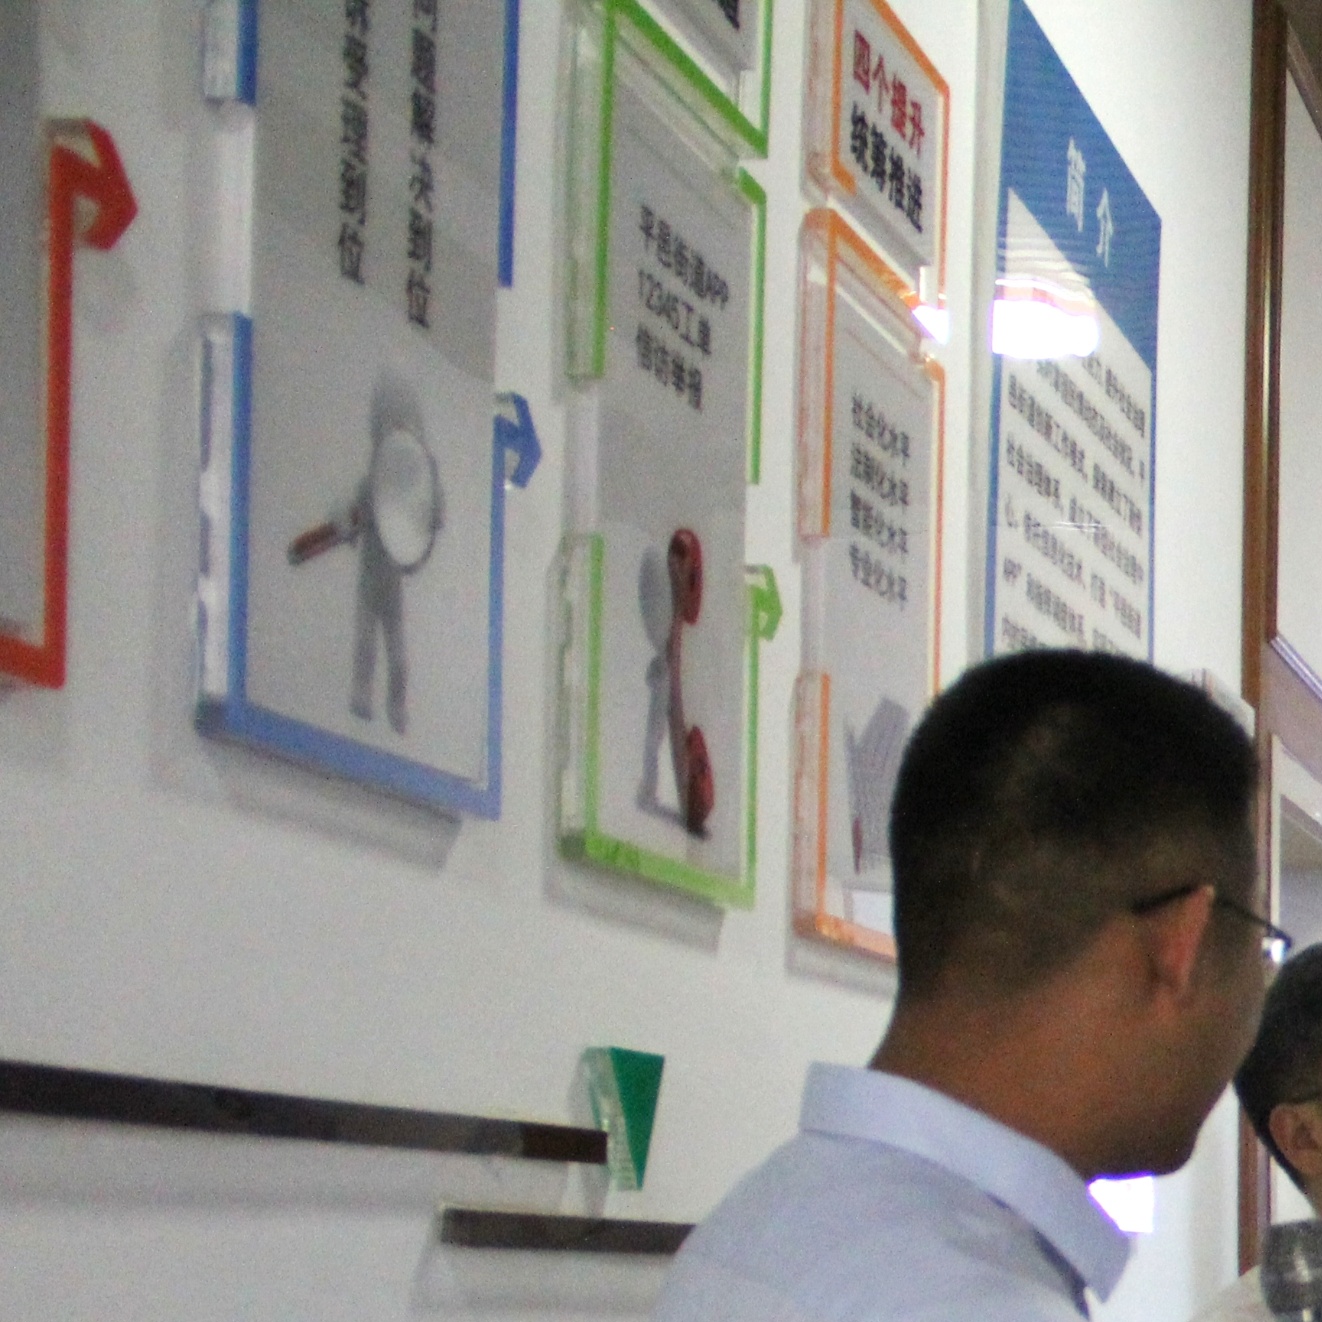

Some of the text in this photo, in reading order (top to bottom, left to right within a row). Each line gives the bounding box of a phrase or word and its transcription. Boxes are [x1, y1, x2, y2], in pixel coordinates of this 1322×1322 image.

[851, 100, 923, 235] 统筹推进
[1066, 135, 1114, 268] 简介
